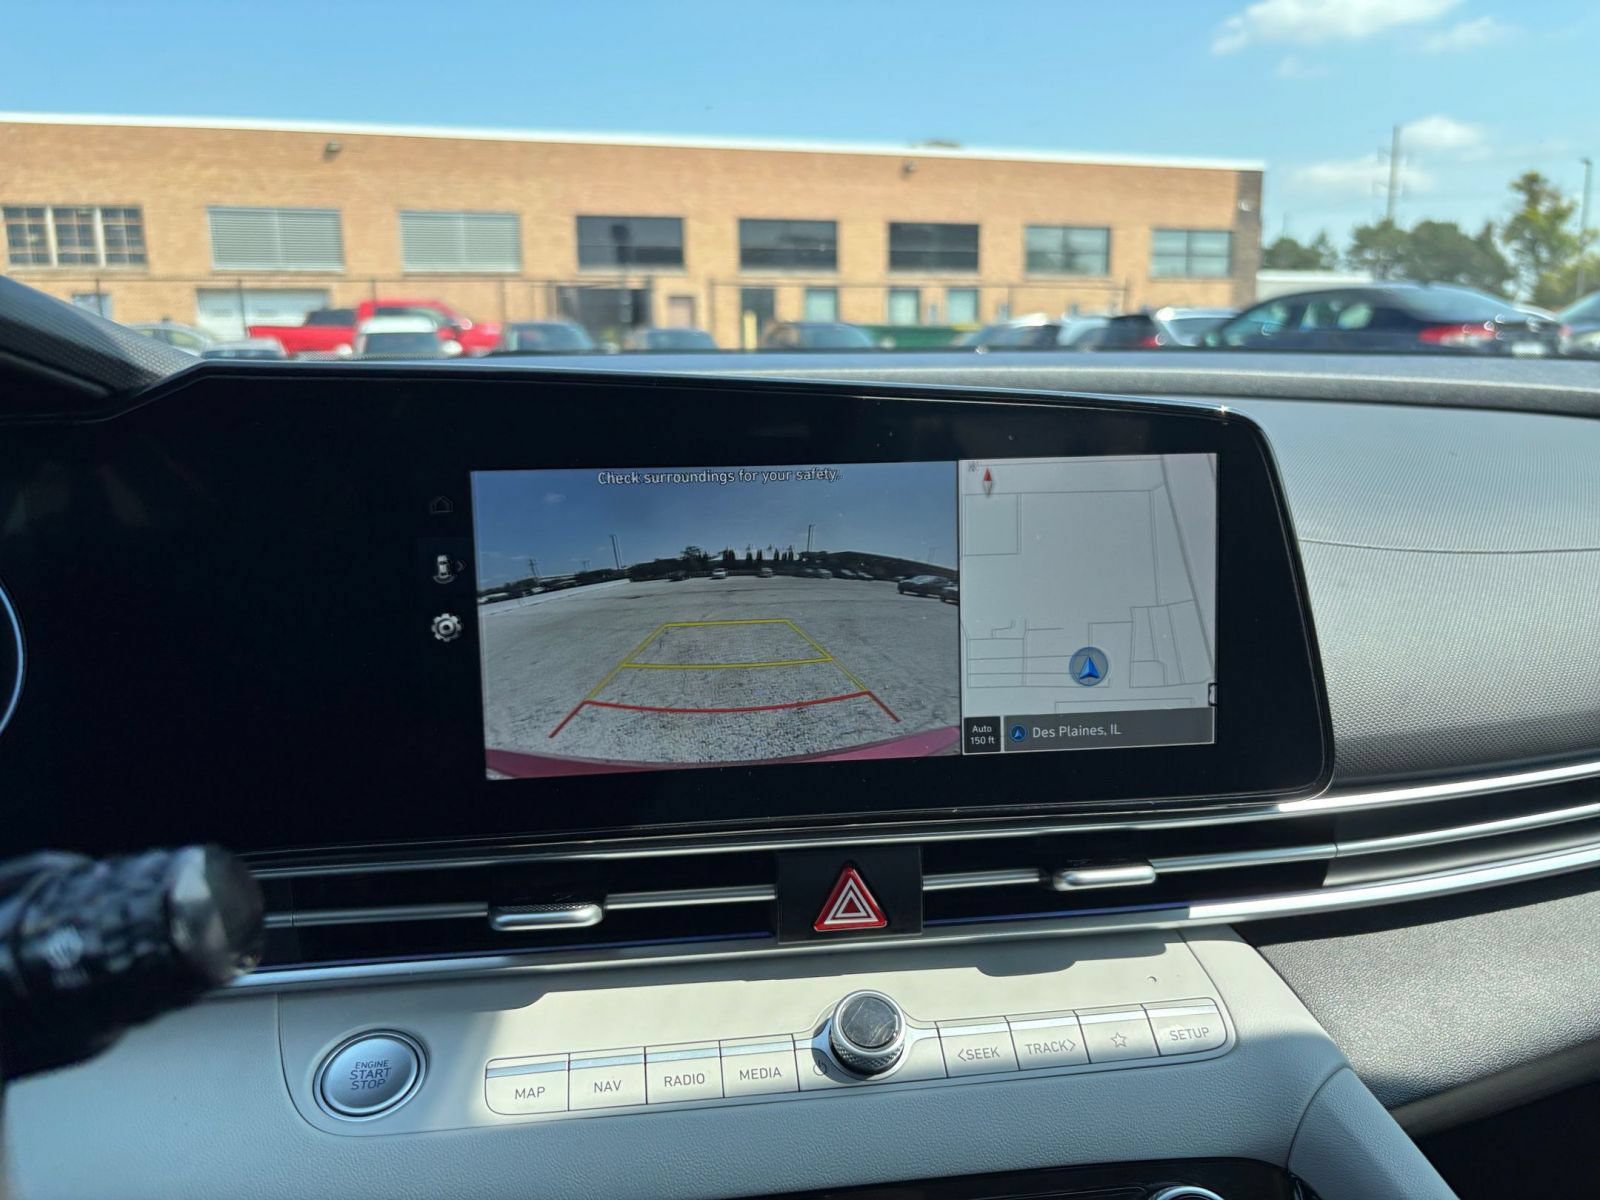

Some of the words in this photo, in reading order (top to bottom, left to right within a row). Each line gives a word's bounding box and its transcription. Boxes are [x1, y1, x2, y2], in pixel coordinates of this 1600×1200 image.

[597, 472, 640, 485] Check
[643, 470, 735, 485] surroundings
[738, 469, 758, 481] for
[761, 470, 790, 483] your
[972, 725, 992, 733] Auto
[1032, 727, 1056, 738] Des
[1059, 725, 1108, 737] Plaines,
[970, 736, 986, 745] 150
[988, 736, 995, 744] ft
[1169, 1027, 1210, 1041] SETUP
[355, 1060, 390, 1069] ENGINE
[350, 1067, 392, 1080] START
[663, 1072, 705, 1087] RADIO
[739, 1066, 782, 1081] MEDIA
[351, 1079, 386, 1090] STOP
[593, 1080, 622, 1093] NAV
[514, 1086, 546, 1100] MAP
